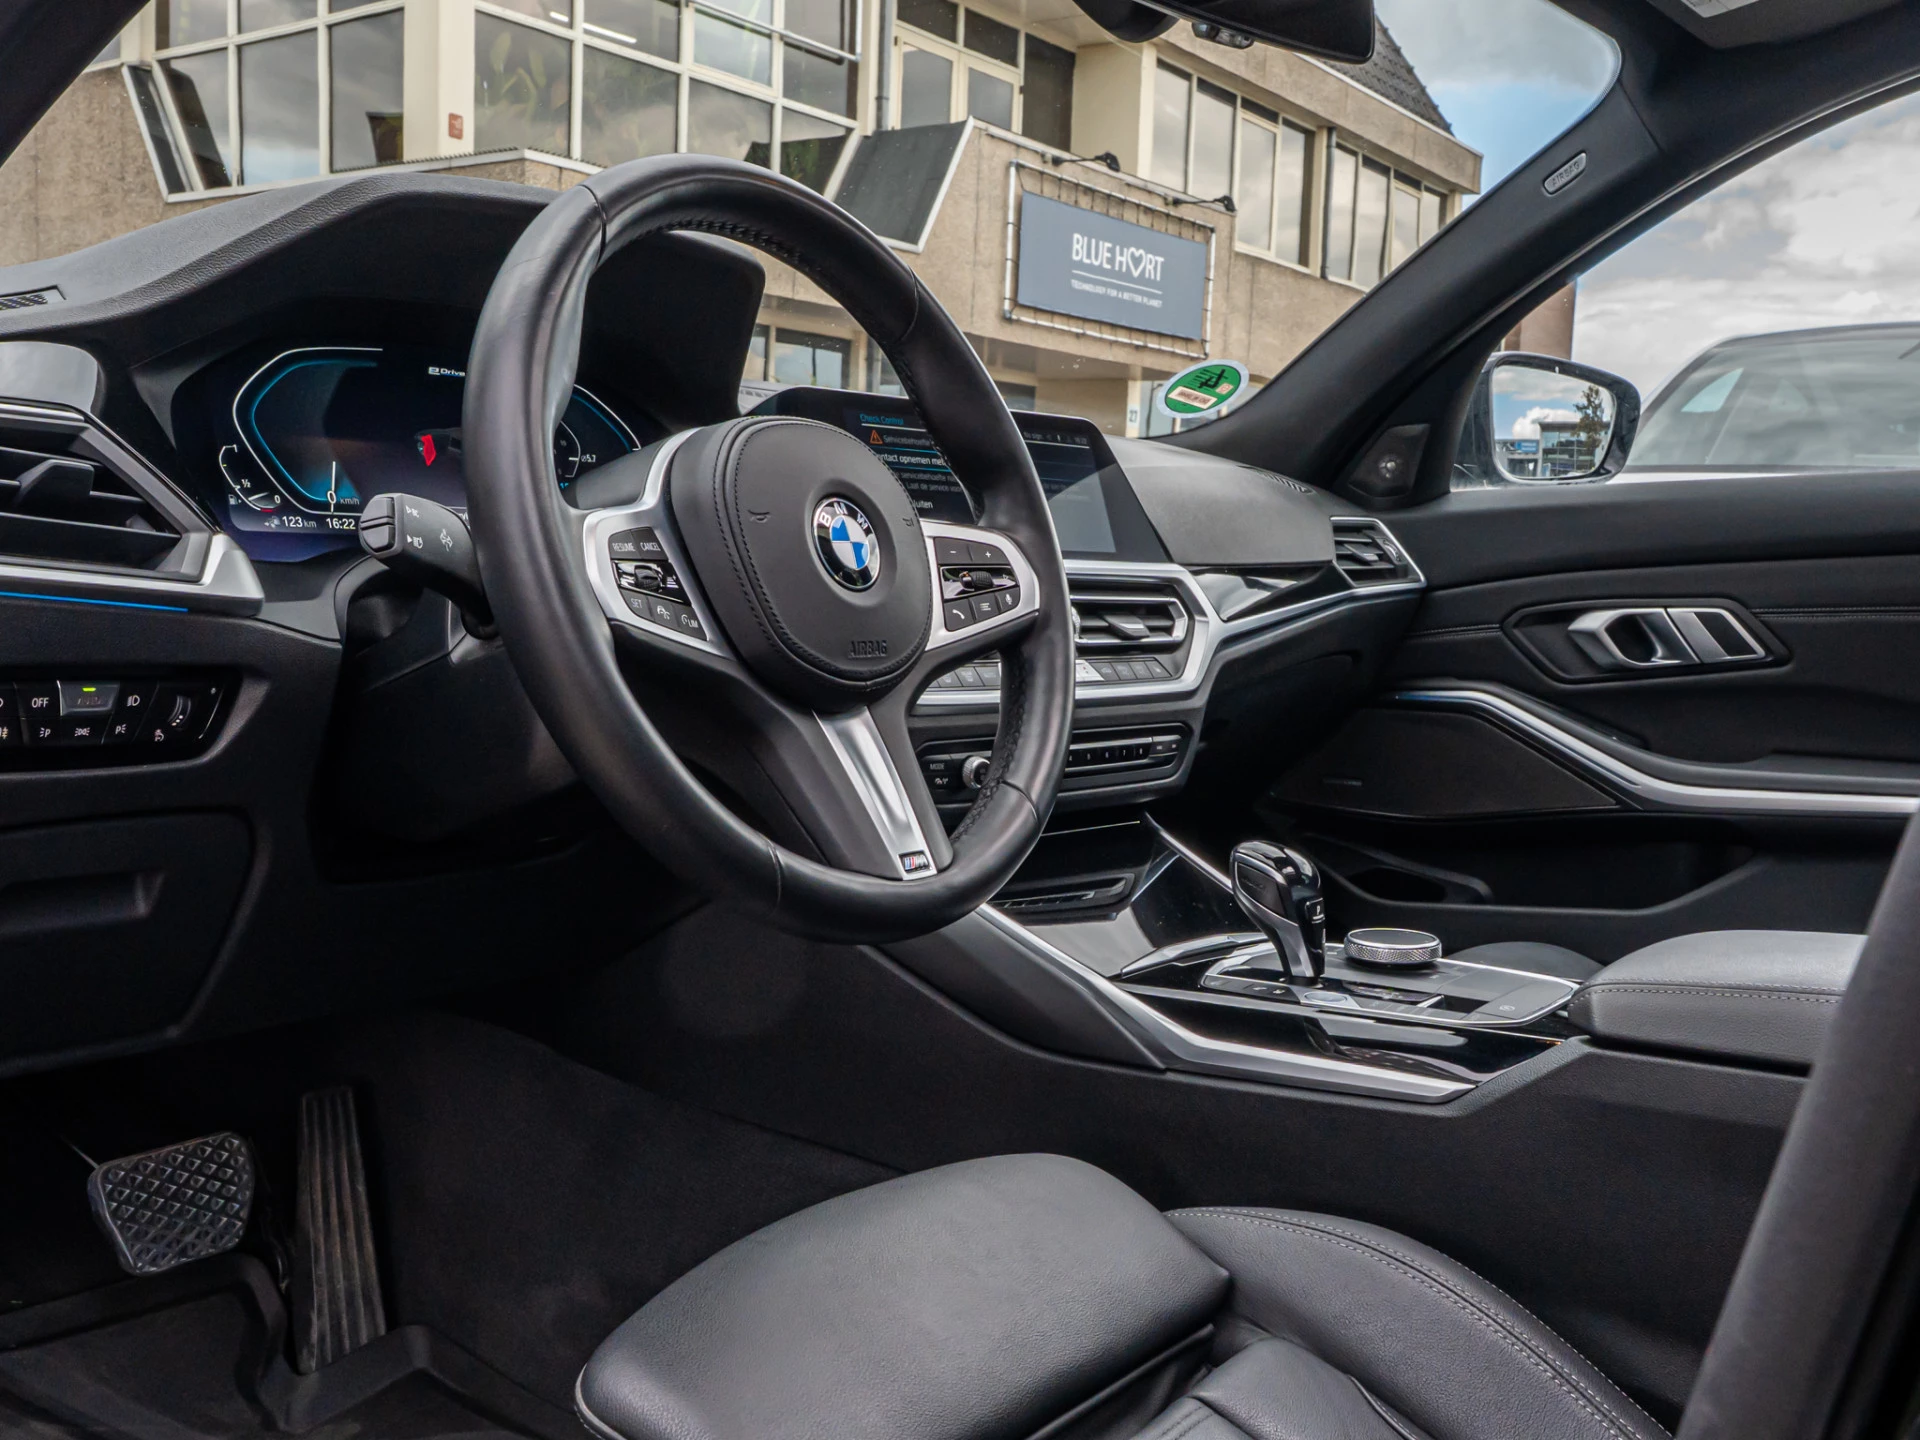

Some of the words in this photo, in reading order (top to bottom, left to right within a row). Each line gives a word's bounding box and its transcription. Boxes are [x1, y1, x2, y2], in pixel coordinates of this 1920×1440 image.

[1551, 161, 1580, 185] AIRBAG
[1072, 233, 1112, 269] BLUE
[860, 413, 880, 422] Check
[881, 417, 903, 425] Control
[900, 457, 931, 467] opnemen
[274, 495, 281, 504] 0
[327, 490, 337, 504] 0
[340, 497, 360, 505] km/h
[818, 502, 869, 530] BMW
[282, 516, 303, 528] 123
[304, 519, 317, 528] km
[326, 518, 356, 529] 16:22
[612, 543, 636, 552] RESUME
[640, 543, 661, 552] CANCEL
[631, 598, 642, 608] SET
[849, 640, 888, 657] AIRBAG
[31, 697, 49, 708] OFF
